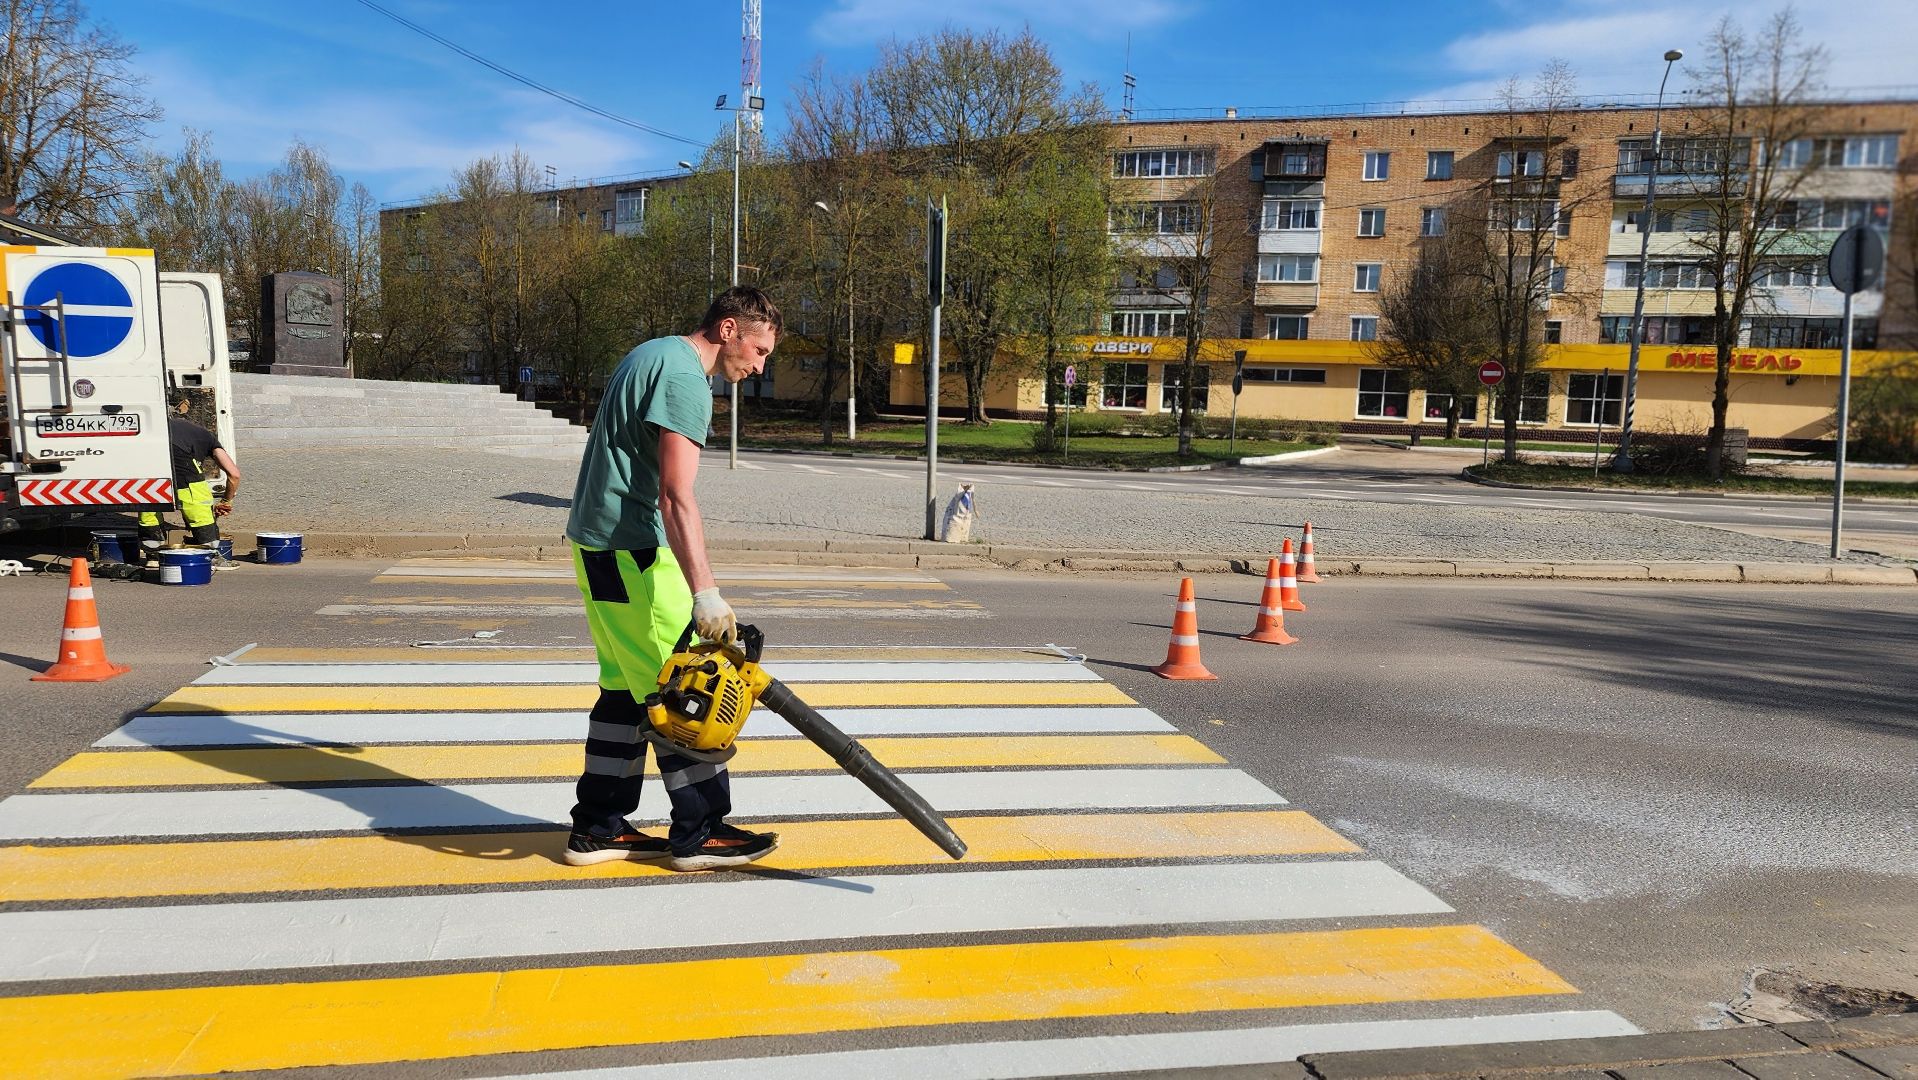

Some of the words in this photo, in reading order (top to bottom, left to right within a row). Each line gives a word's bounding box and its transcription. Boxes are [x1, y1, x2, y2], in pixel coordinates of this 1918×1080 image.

[1093, 341, 1154, 354] ДВЕРИ
[109, 416, 135, 427] 799
[40, 447, 105, 457] Ducato
